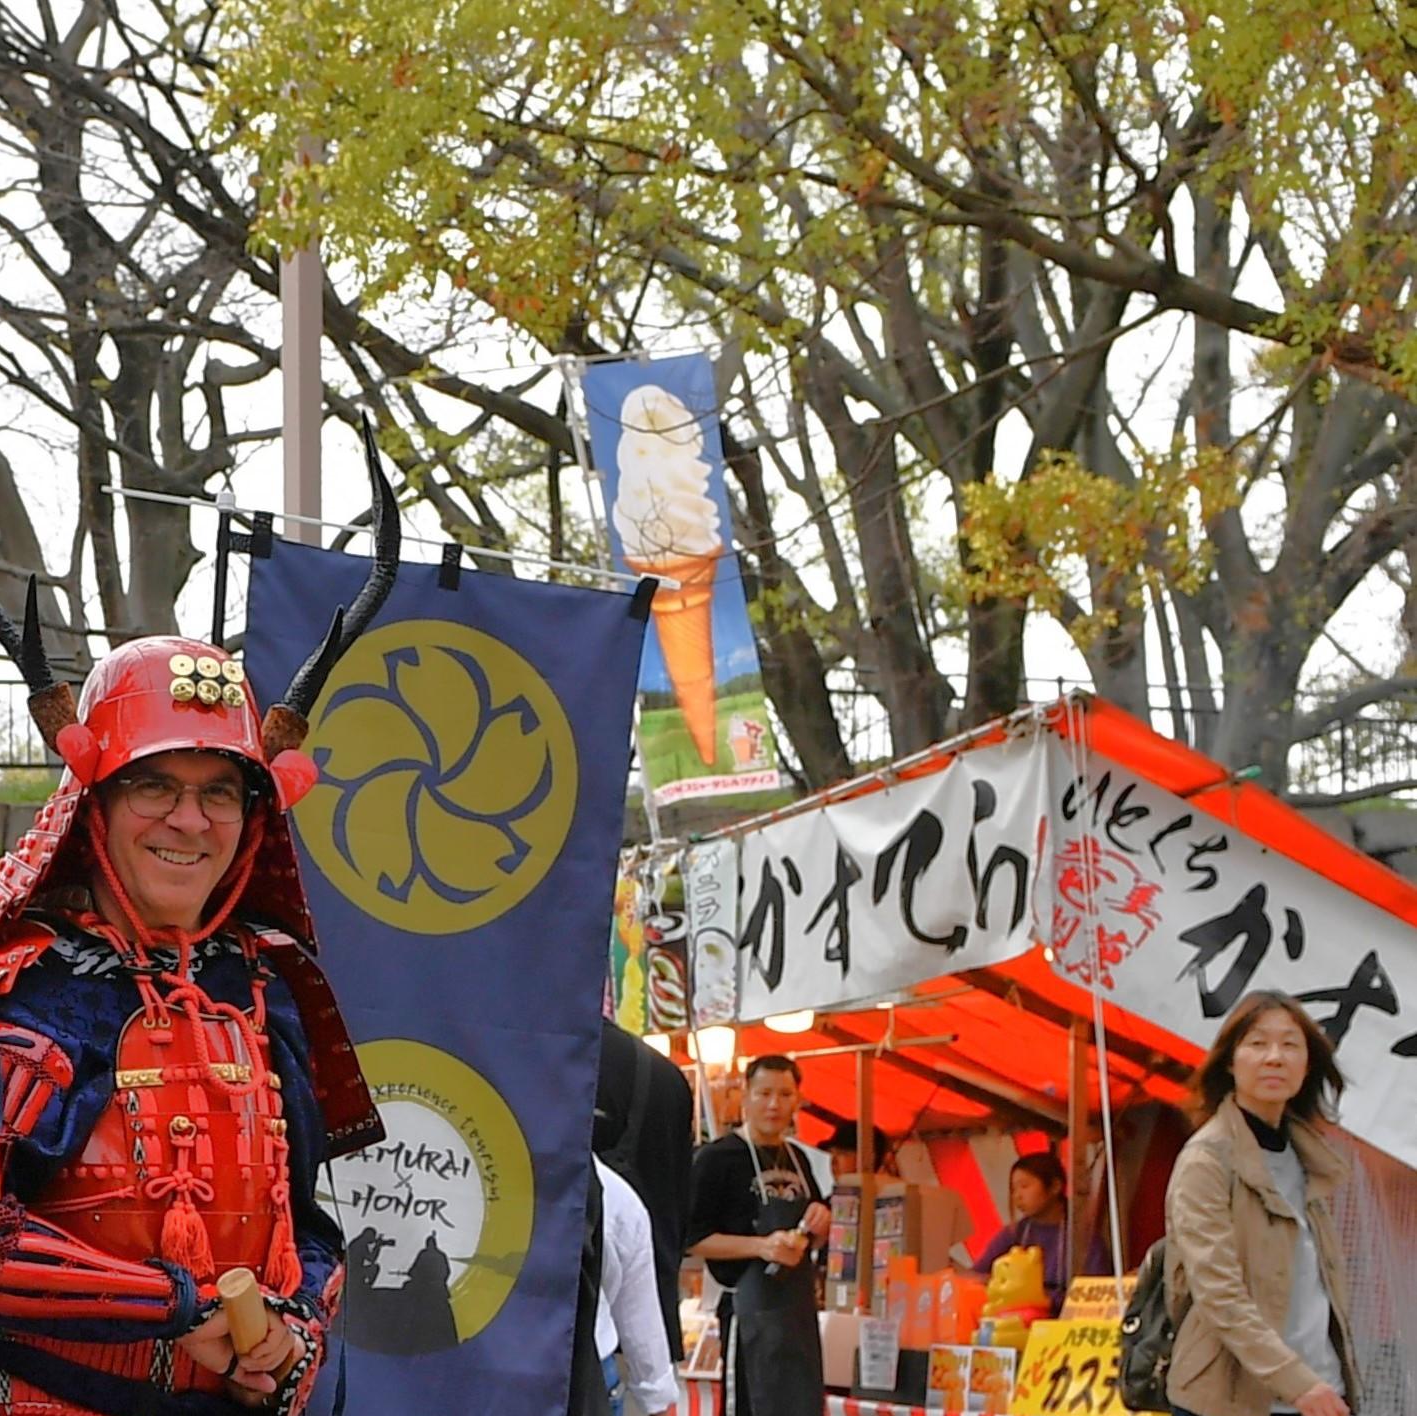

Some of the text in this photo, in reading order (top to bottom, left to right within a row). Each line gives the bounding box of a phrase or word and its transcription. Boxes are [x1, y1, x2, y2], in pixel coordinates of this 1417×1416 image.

[738, 778, 1029, 994] かすてら
[369, 1081, 457, 1114] xperience
[344, 1141, 471, 1180] AMURAI
[350, 1184, 456, 1229] HONOR
